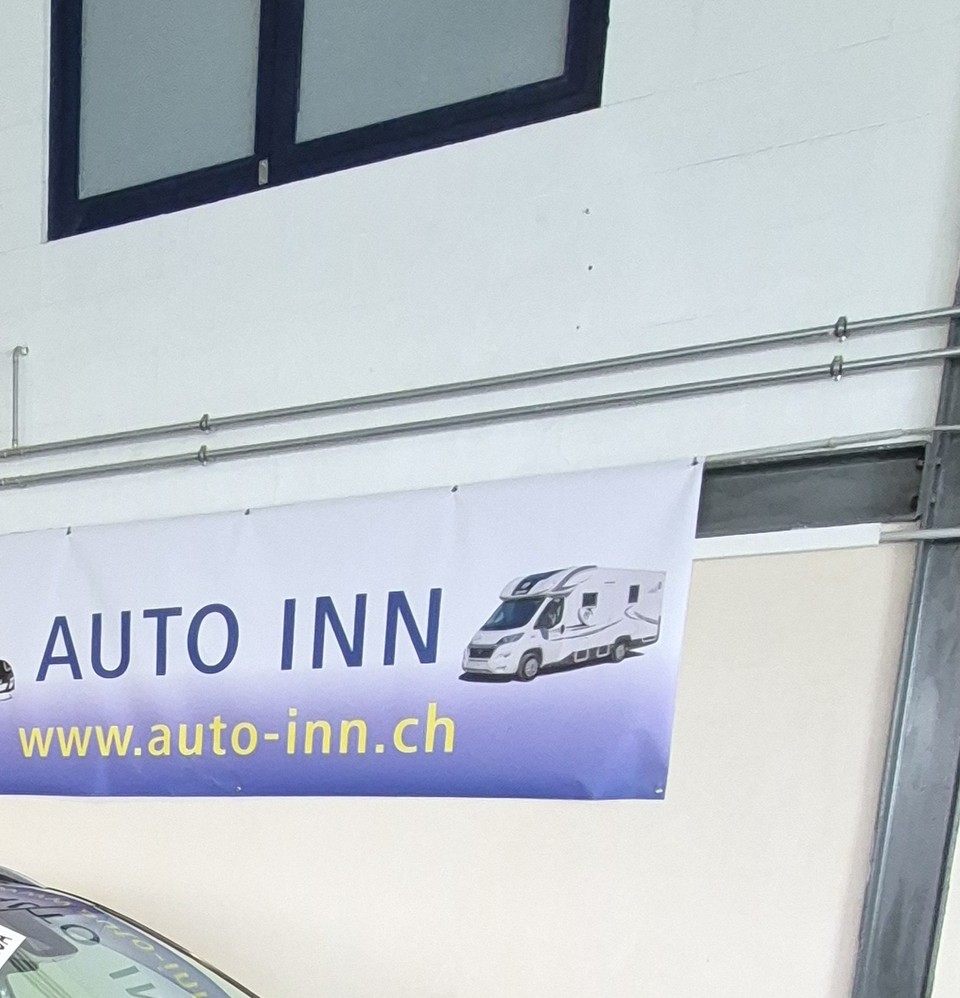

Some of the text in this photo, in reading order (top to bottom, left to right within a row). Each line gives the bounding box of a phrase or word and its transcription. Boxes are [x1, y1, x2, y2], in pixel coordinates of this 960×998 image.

[35, 587, 443, 682] AUTO INN
[18, 701, 457, 758] www.auto-inn.ch
